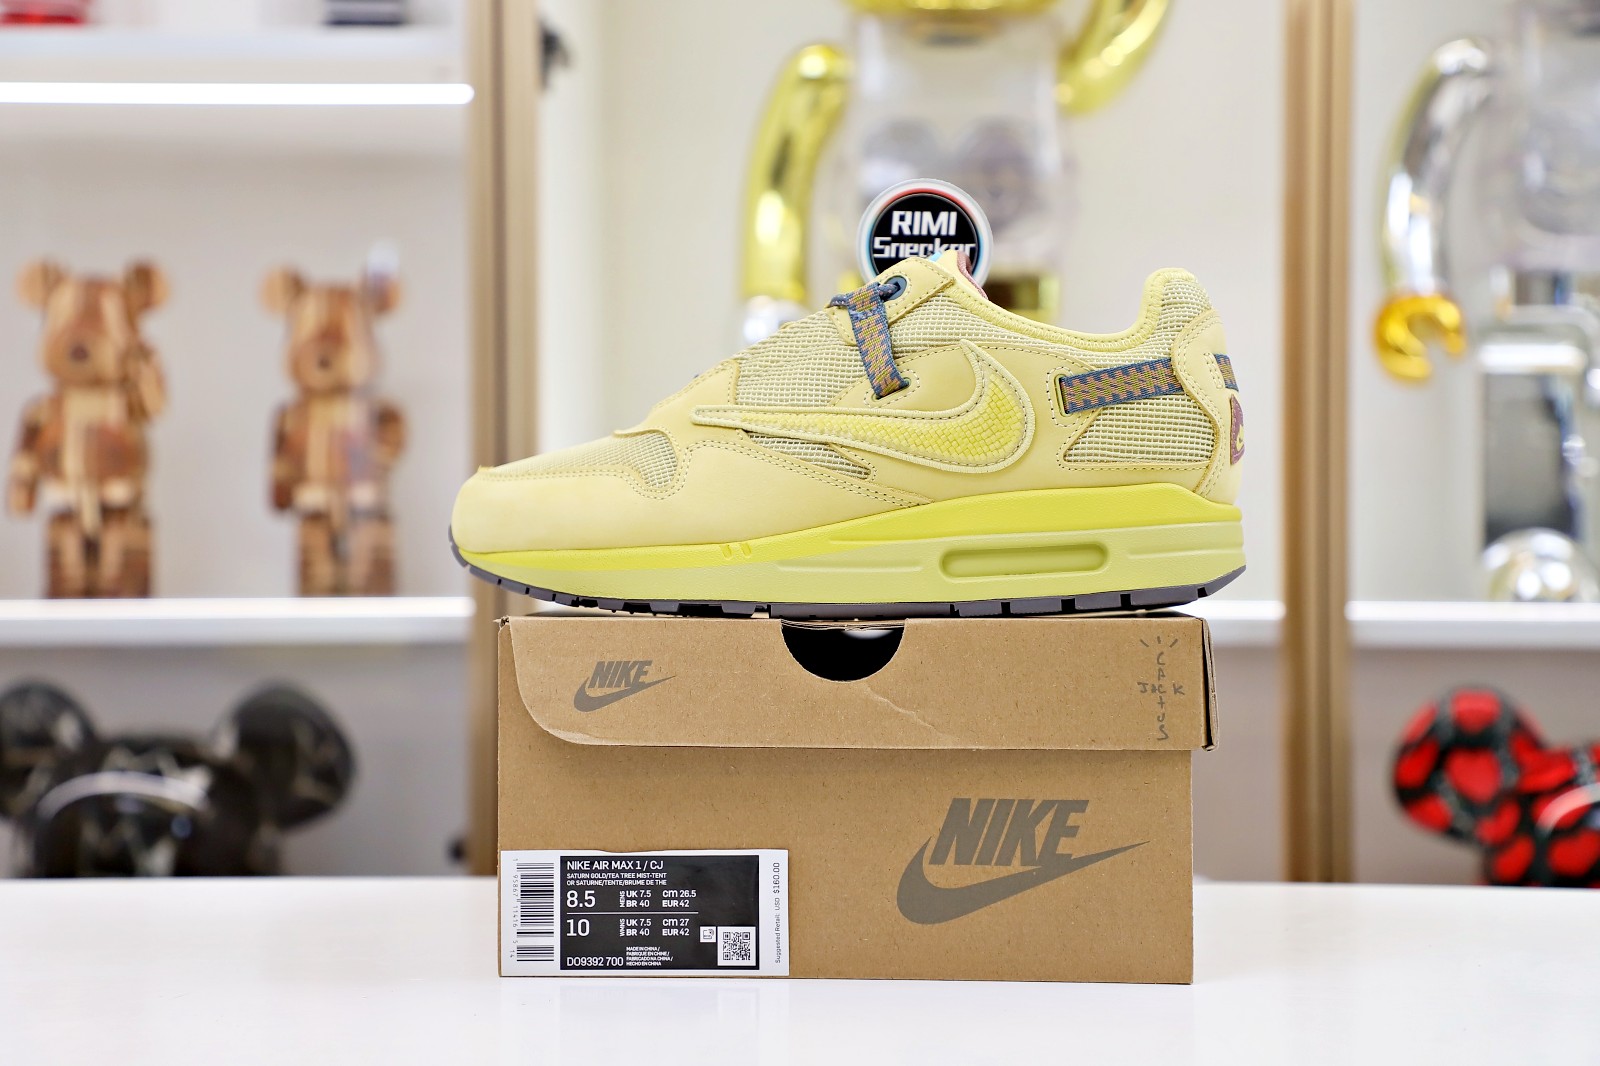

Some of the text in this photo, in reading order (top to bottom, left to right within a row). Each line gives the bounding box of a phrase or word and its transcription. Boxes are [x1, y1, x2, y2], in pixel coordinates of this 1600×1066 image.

[891, 211, 957, 236] RIMI
[588, 661, 653, 688] NIKE
[928, 798, 1089, 867] NIKE
[567, 861, 590, 870] NIKE
[592, 861, 610, 870] AIR
[612, 861, 634, 870] MAX
[636, 861, 642, 870] 1
[650, 861, 664, 870] CJ
[772, 862, 780, 894] $160.00
[566, 890, 596, 908] 8.5
[566, 919, 590, 936] 10
[640, 918, 652, 926] 7.5
[680, 918, 690, 926] 27
[606, 957, 624, 966] 700
